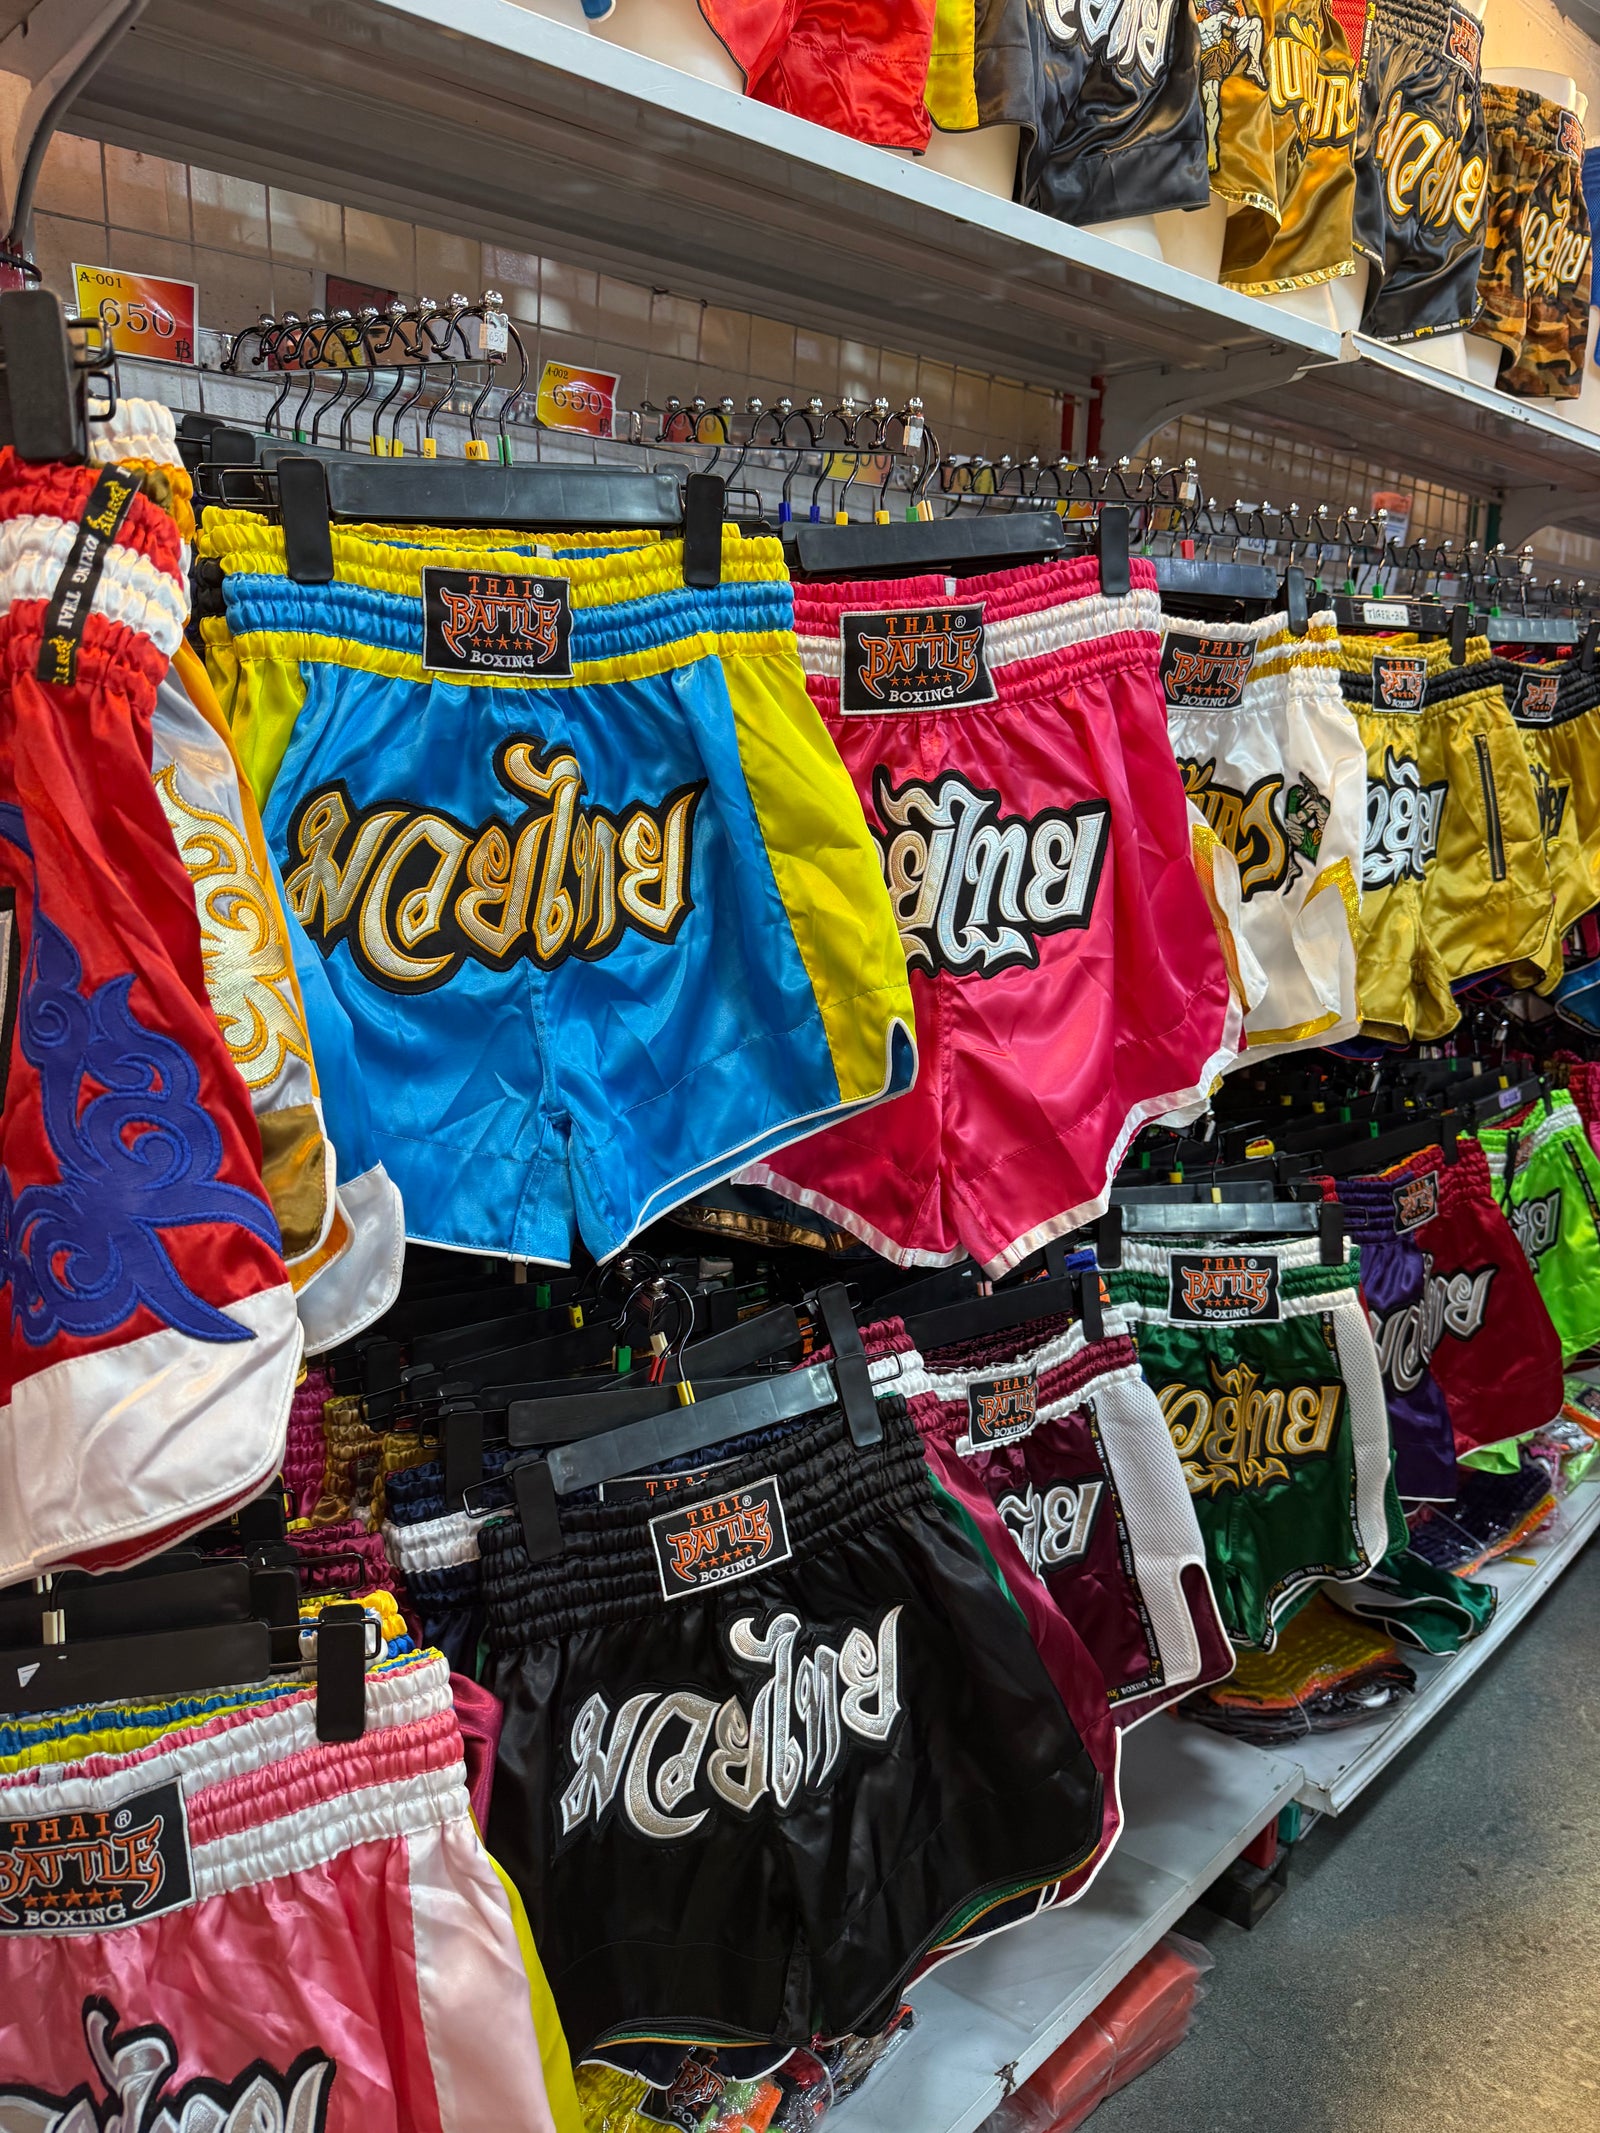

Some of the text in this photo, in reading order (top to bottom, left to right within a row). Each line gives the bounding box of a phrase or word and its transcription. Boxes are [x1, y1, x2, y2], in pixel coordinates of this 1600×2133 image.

[80, 271, 122, 289] A-001
[98, 297, 176, 338] 650
[552, 384, 603, 415] 650
[468, 576, 533, 599] THAI
[57, 590, 82, 630] THAI
[439, 587, 562, 664] BATTLE
[886, 615, 952, 635] THAI
[470, 650, 534, 668] BOXING
[858, 625, 983, 699] BATTLE
[1199, 640, 1245, 656] THAI
[1165, 648, 1253, 704] BATTLE
[889, 686, 954, 704] BOXING
[1180, 694, 1227, 707] BOXING
[1202, 1257, 1247, 1271] THAI
[1181, 1266, 1271, 1314] BATTLE
[1203, 1307, 1250, 1319] BOXING
[993, 1376, 1029, 1393] THAI
[687, 1496, 742, 1526] THAI
[665, 1499, 773, 1583] BATTLE
[699, 1555, 756, 1583] BOXING
[560, 1605, 904, 1839] มวยไทย
[11, 1813, 111, 1845] THAI
[24, 1902, 126, 1927] BOXING
